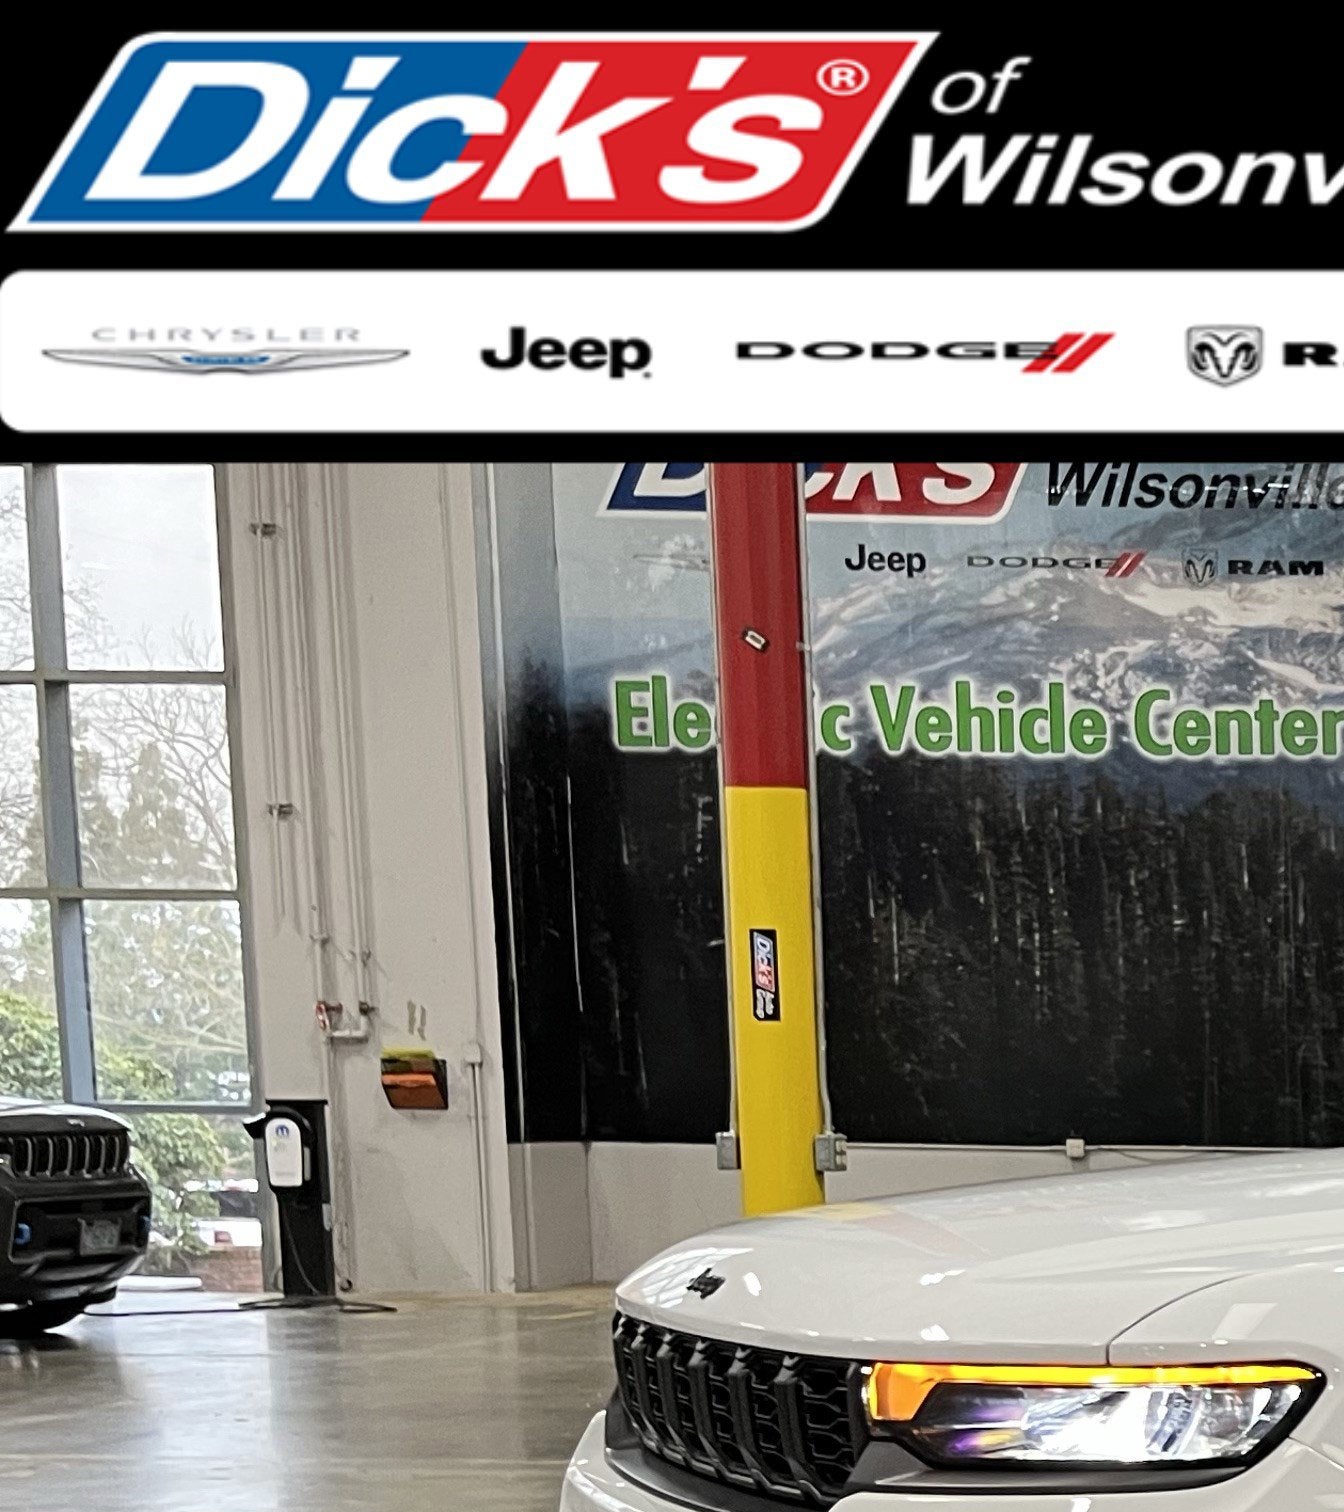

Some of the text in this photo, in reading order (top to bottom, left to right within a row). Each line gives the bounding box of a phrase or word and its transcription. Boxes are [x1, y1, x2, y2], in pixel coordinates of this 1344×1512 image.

[844, 543, 926, 578] Jeep
[966, 555, 1117, 570] DODGE
[1227, 559, 1324, 576] RAM
[615, 674, 851, 752] Elec
[869, 680, 1107, 753] Vehicle
